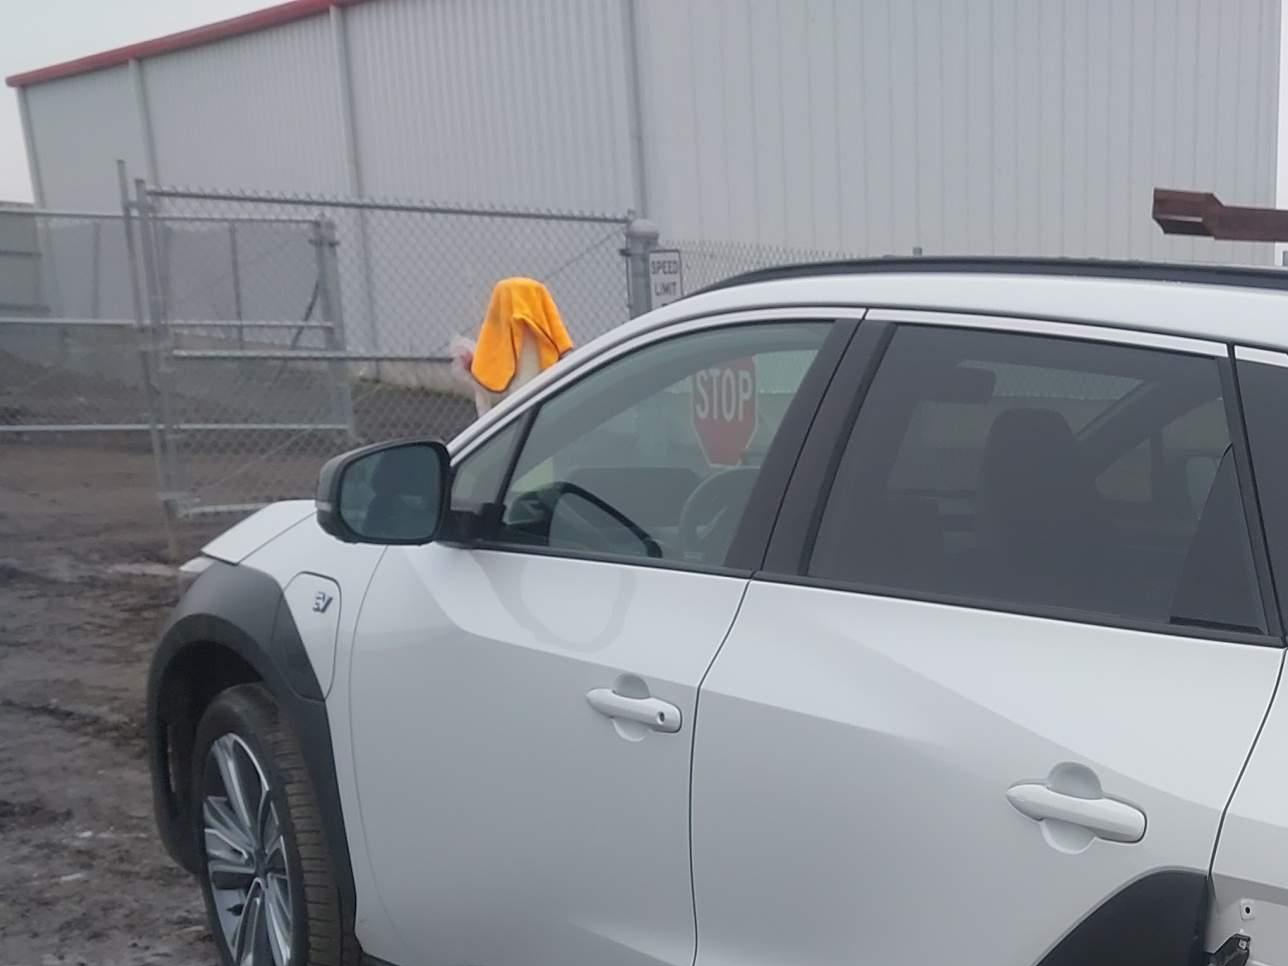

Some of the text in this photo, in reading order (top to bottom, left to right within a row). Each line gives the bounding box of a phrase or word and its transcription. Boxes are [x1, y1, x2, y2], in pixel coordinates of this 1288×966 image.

[651, 260, 678, 275] SPEED
[655, 281, 677, 296] LIMIT
[696, 368, 753, 422] STOP
